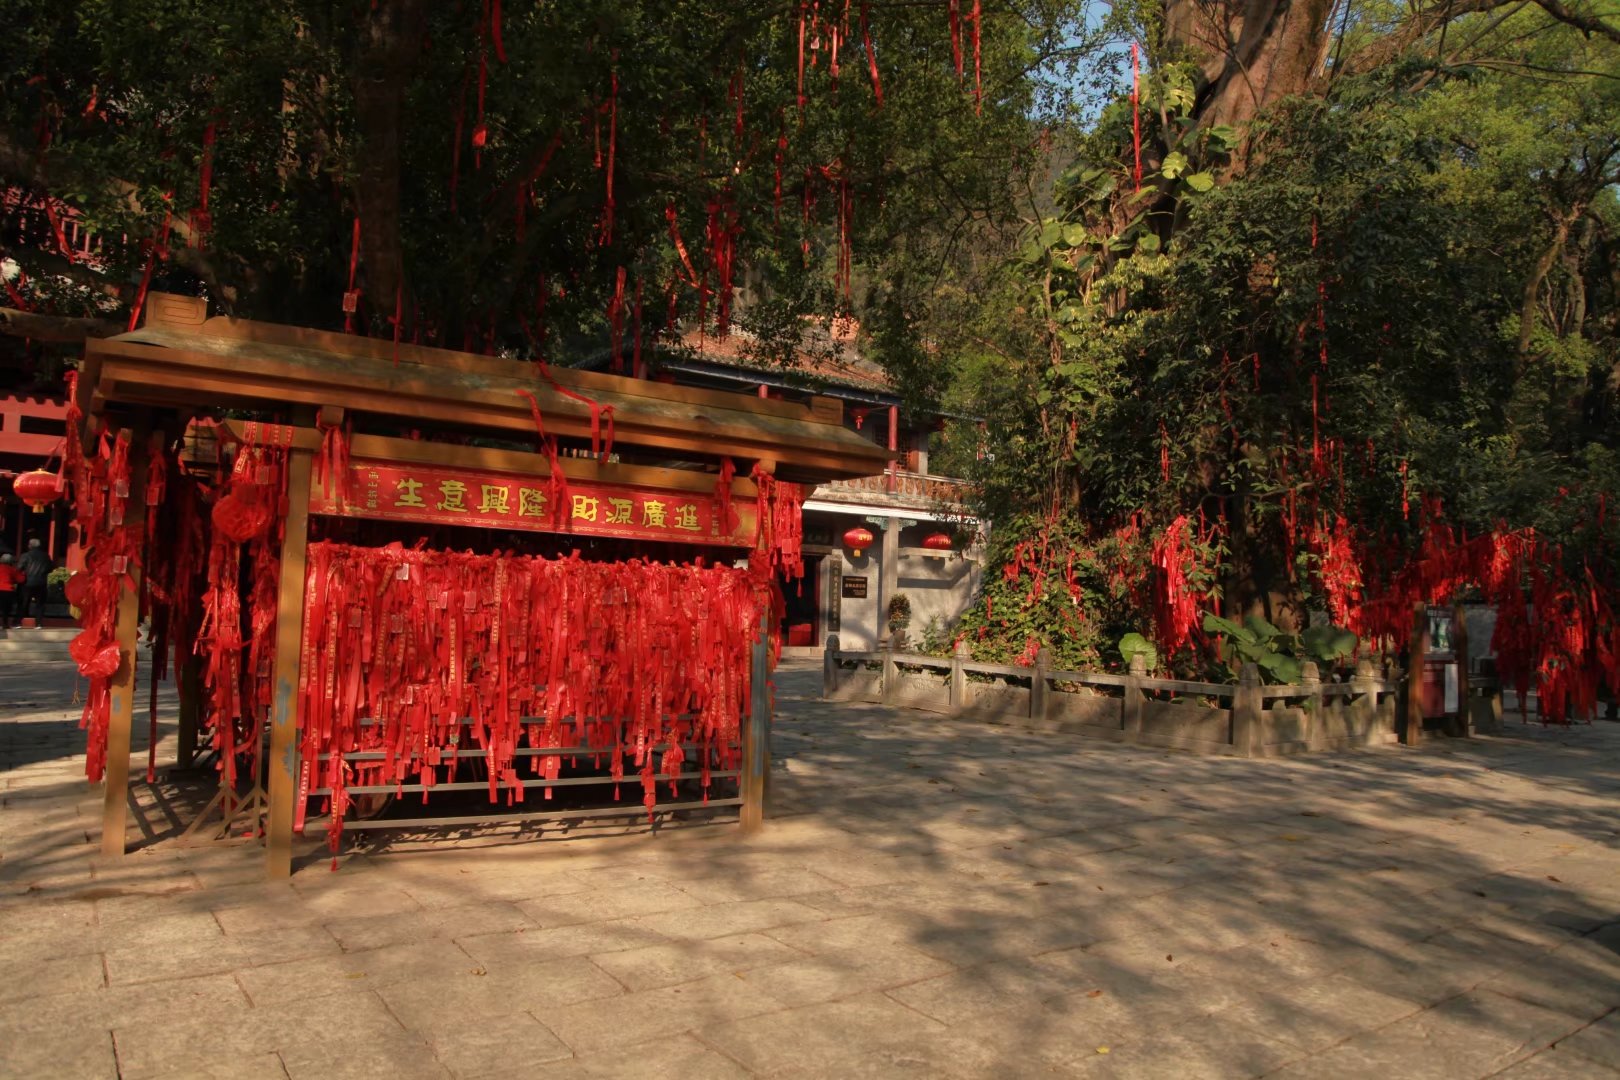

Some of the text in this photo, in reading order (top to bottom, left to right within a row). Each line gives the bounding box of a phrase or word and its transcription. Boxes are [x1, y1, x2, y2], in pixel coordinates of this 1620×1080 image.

[394, 478, 548, 517] 生意興隆
[571, 495, 702, 531] 財源廣進
